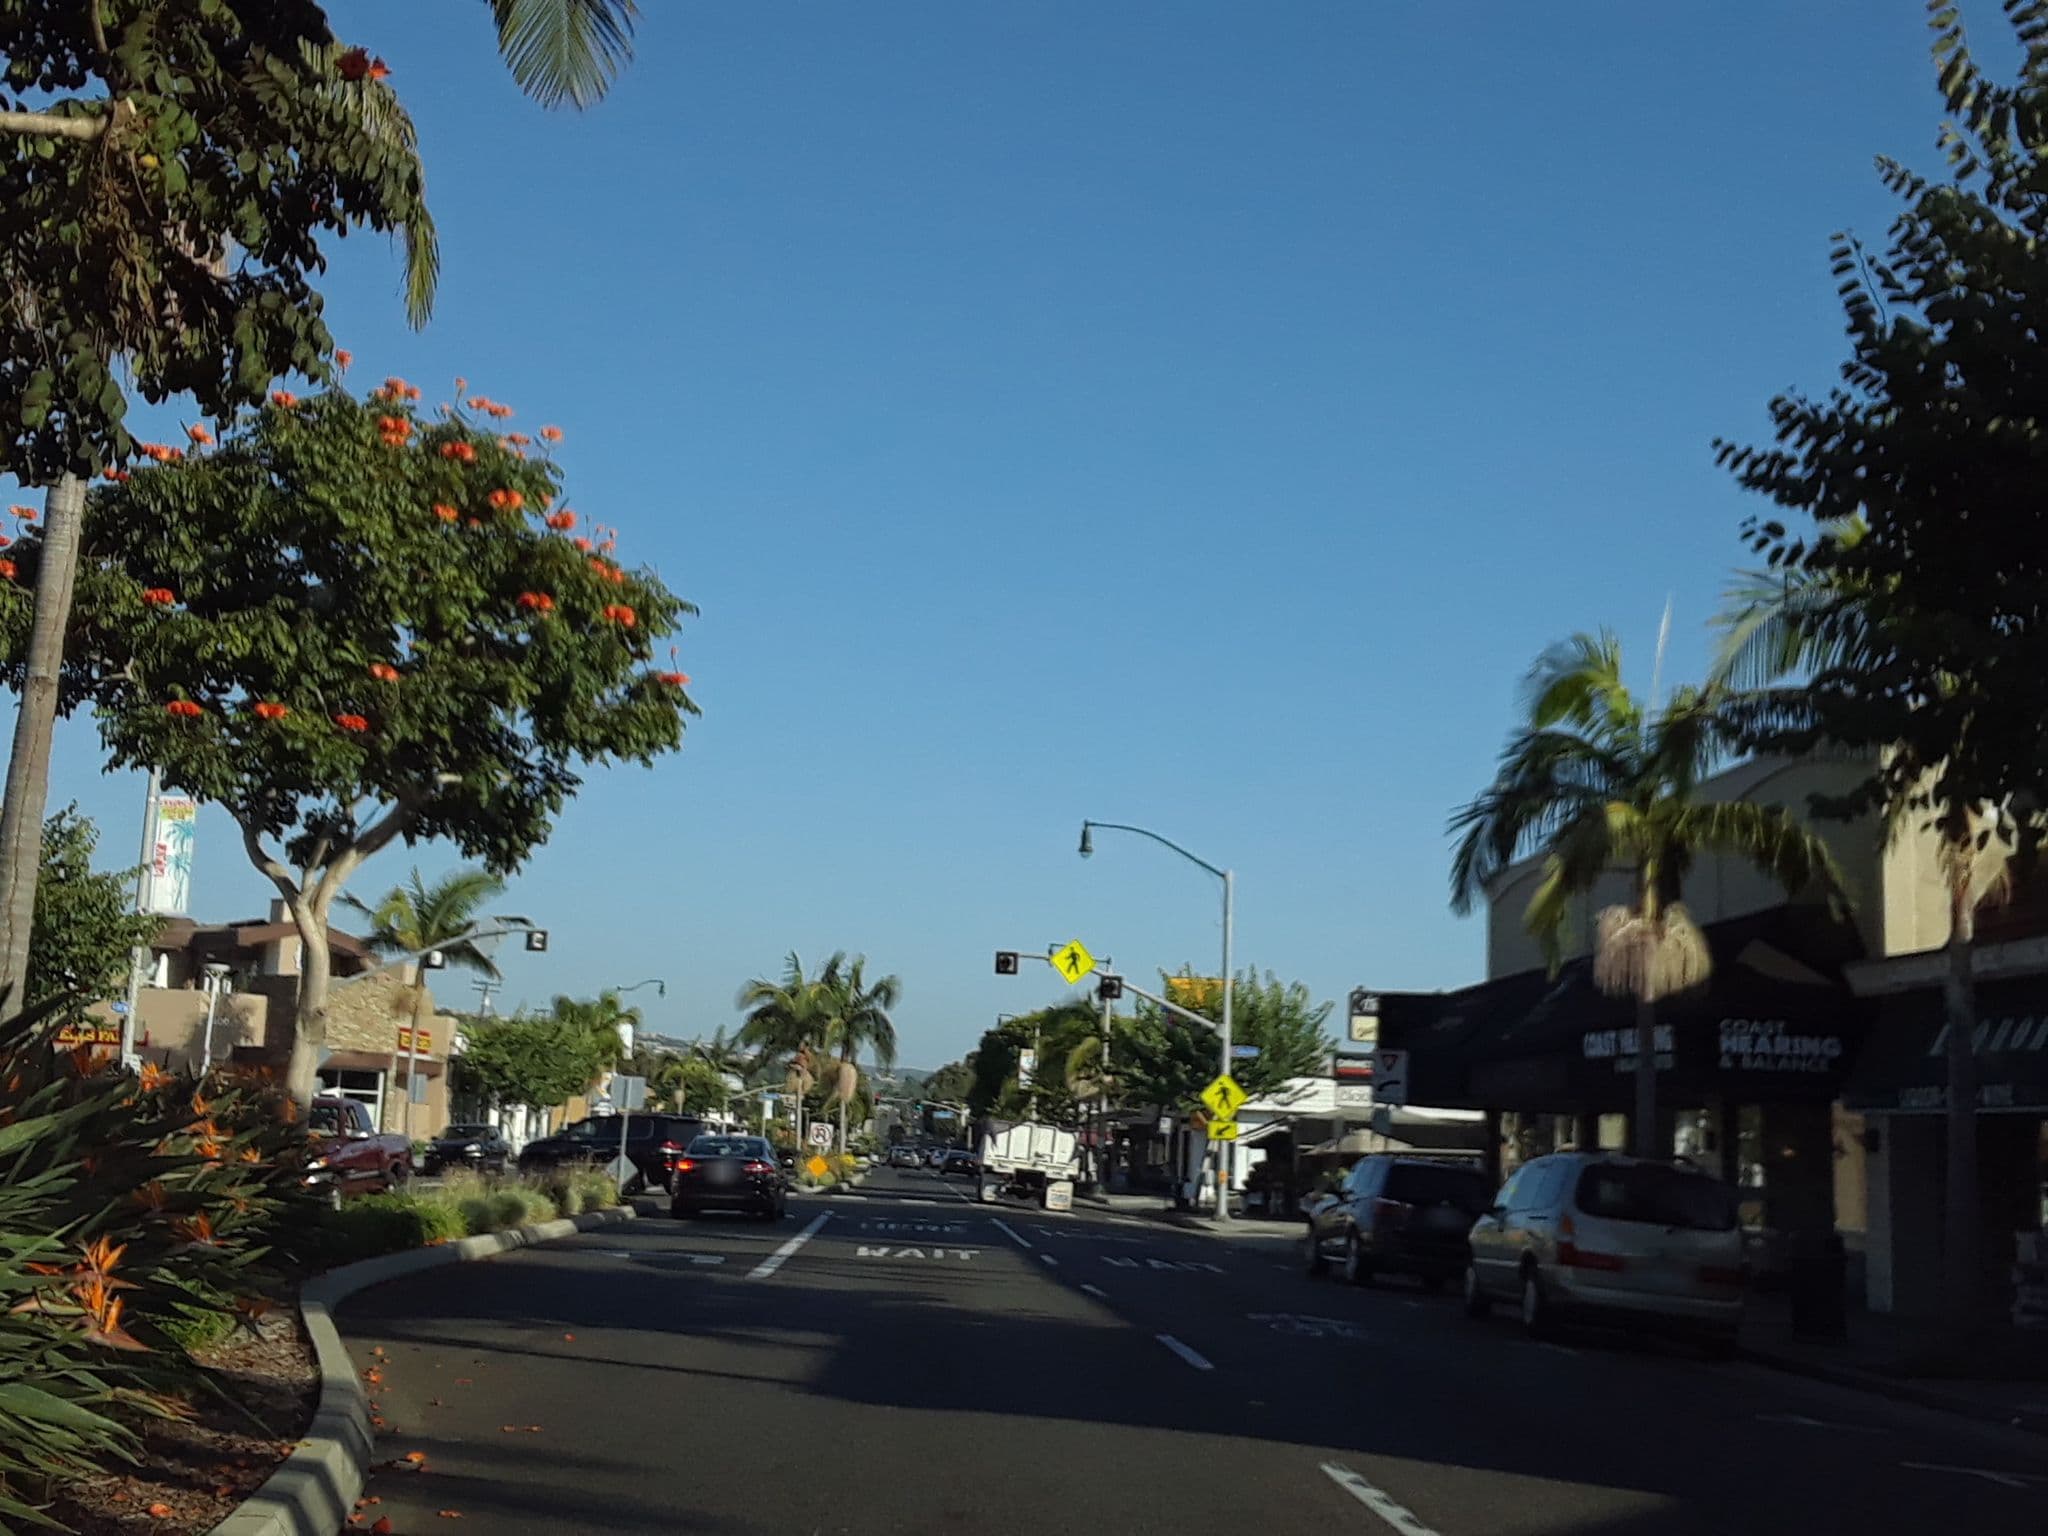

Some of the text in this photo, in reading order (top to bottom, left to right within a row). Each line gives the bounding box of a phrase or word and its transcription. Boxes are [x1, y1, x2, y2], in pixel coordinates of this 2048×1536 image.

[1720, 1018, 1785, 1034] COAST
[1720, 1035, 1841, 1056] HEARING
[1742, 1055, 1830, 1072] BALANCE
[856, 1246, 980, 1261] WAIT
